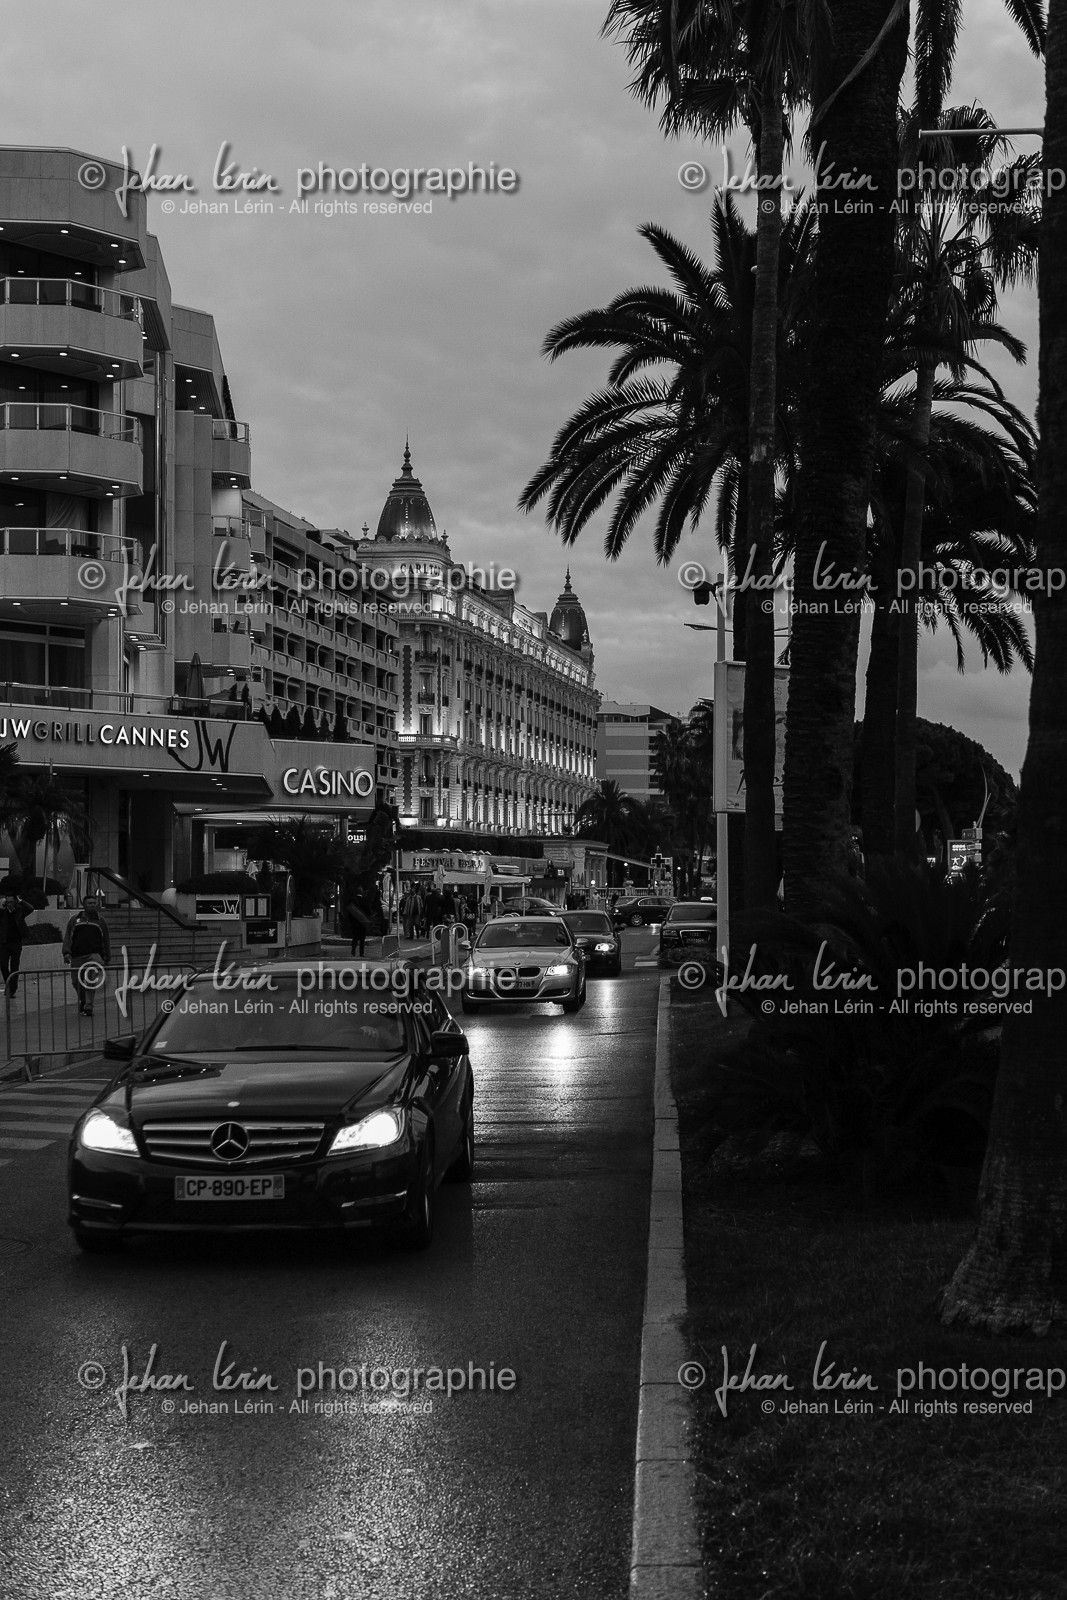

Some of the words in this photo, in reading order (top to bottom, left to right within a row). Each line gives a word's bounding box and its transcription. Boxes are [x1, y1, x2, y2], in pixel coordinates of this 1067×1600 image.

[0, 718, 31, 739] JW
[33, 720, 97, 742] GRILL
[98, 724, 190, 749] CANNES
[281, 766, 375, 798] CASINO
[185, 1178, 273, 1197] CP-890-EP
